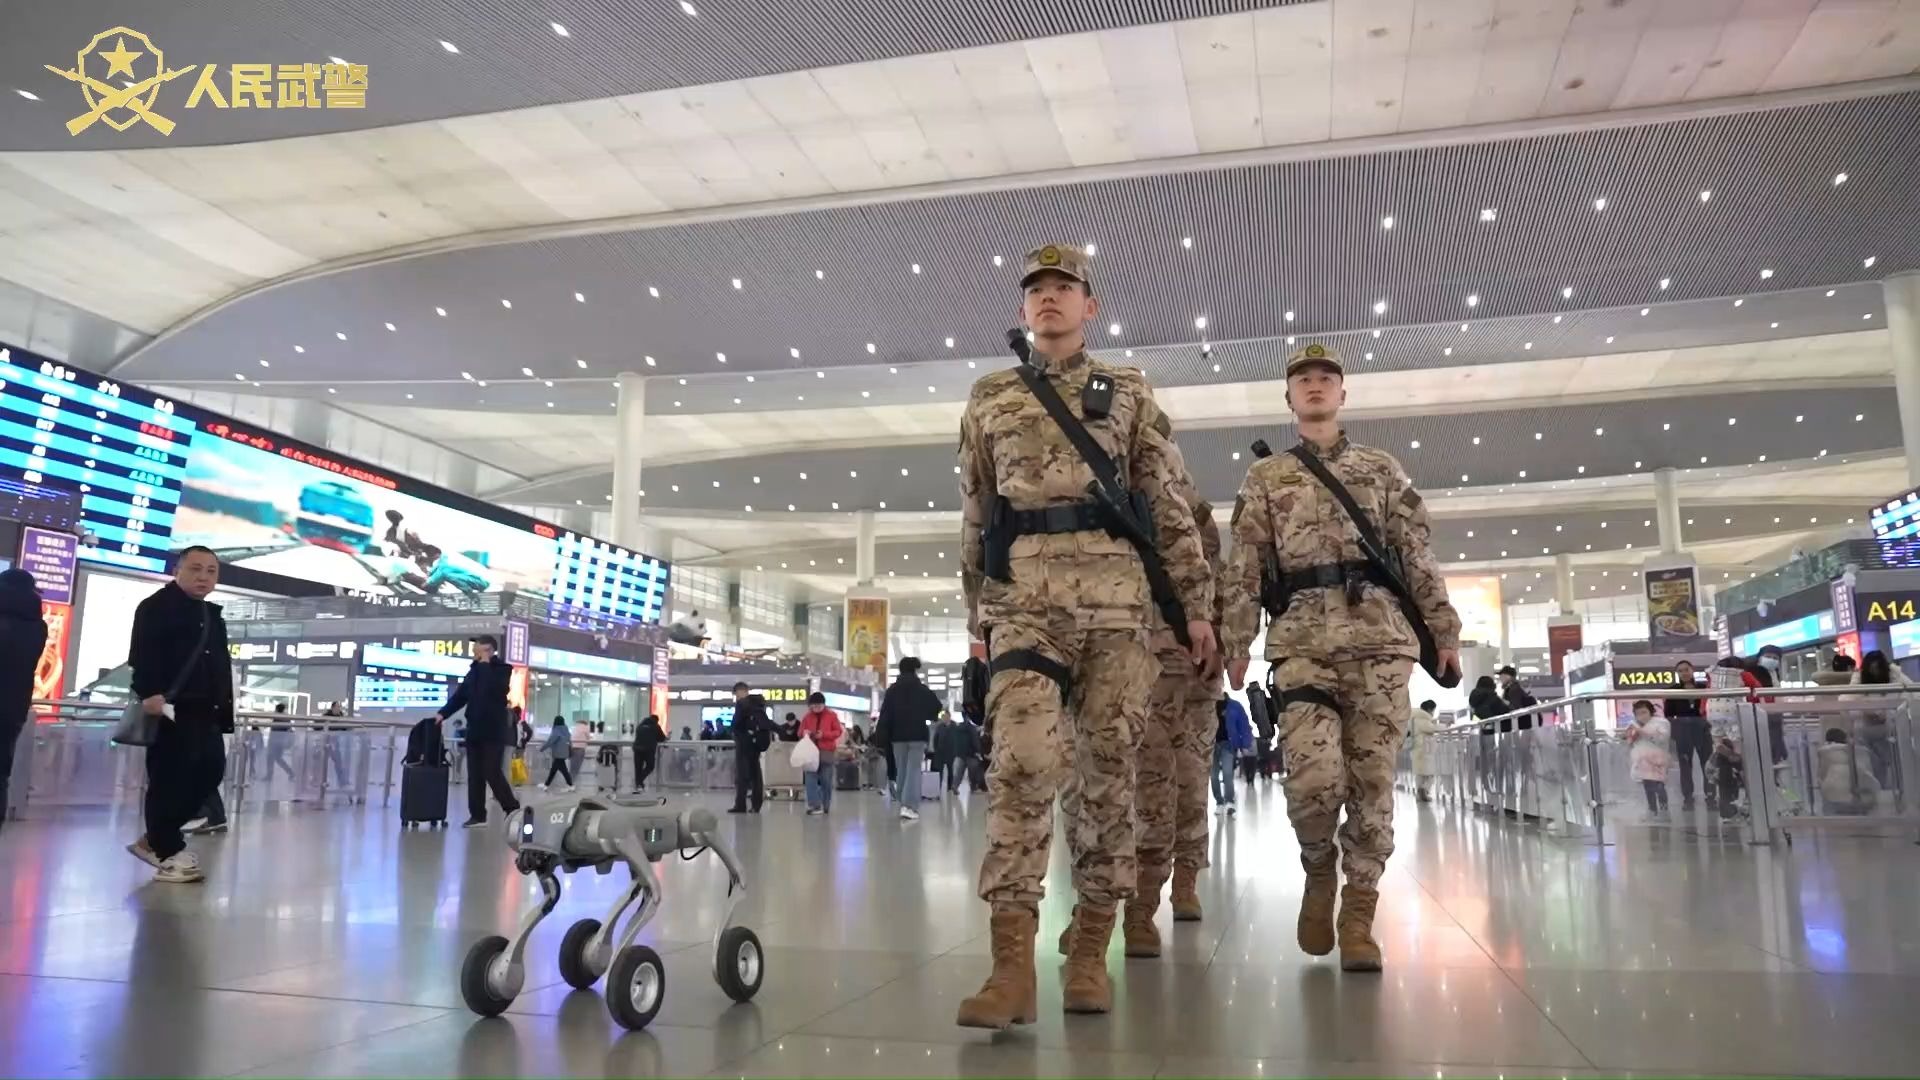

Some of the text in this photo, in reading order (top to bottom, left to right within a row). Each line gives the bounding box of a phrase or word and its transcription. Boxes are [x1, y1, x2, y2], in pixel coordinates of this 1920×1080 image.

[1868, 600, 1916, 621] A14
[435, 640, 463, 656] B14
[551, 812, 564, 824] 02
